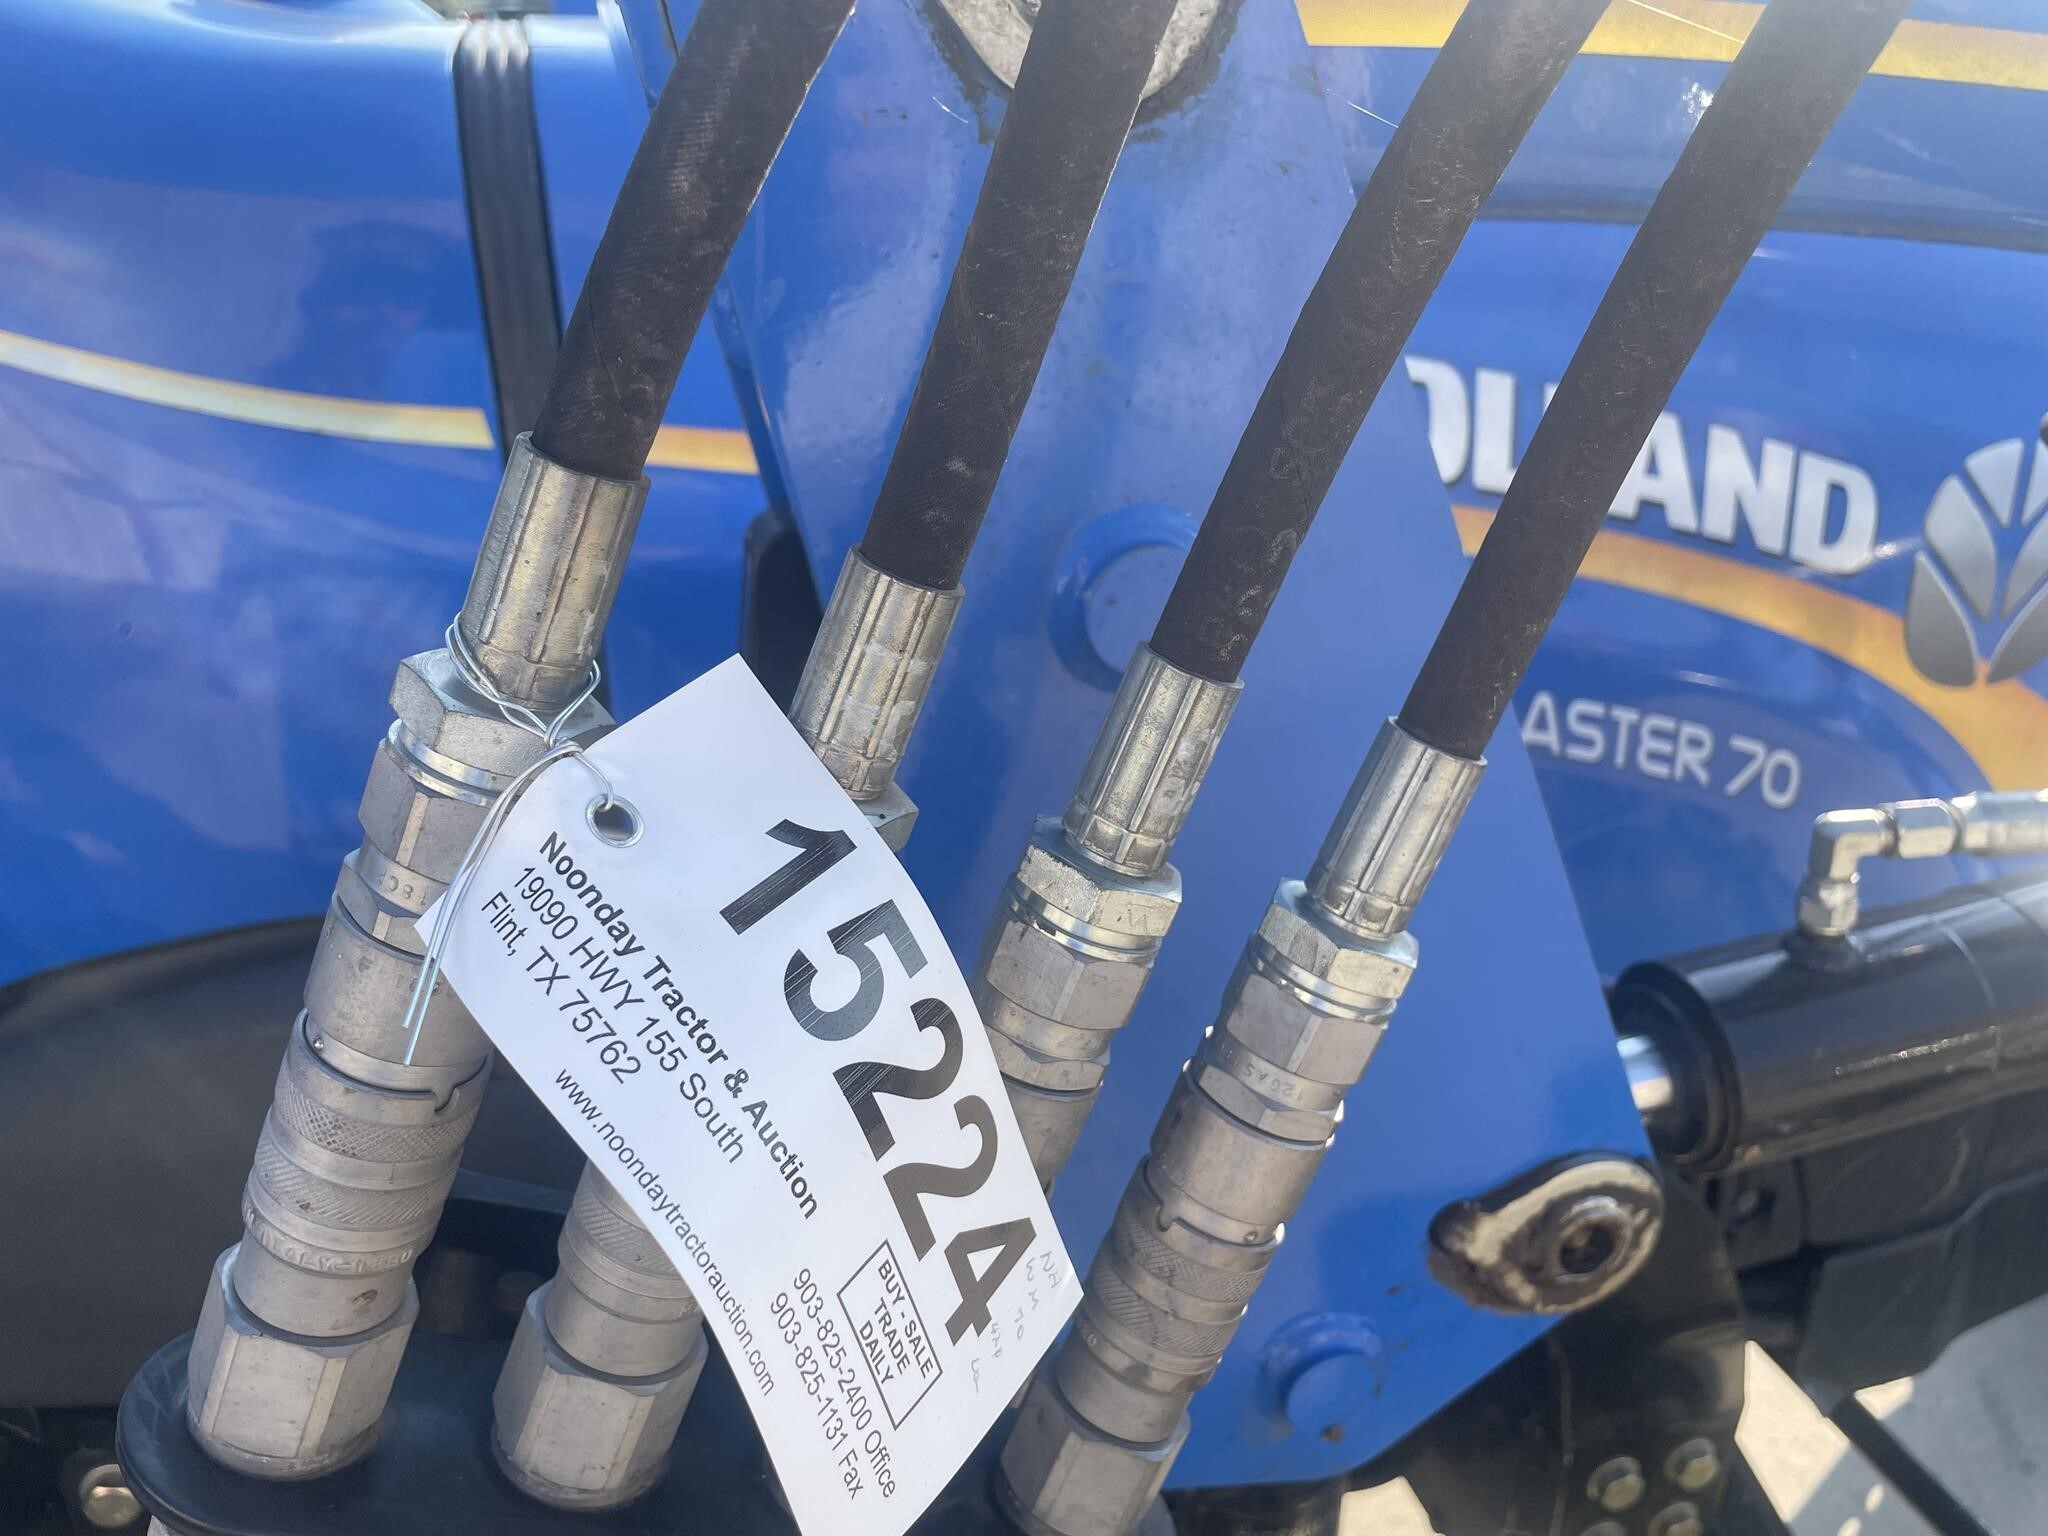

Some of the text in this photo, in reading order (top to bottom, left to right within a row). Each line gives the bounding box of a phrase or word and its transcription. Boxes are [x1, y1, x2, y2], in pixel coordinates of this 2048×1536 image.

[1520, 690, 1800, 811] ASTER 70
[481, 891, 641, 1084] Flint, TX 75762
[514, 867, 744, 1164] 19090 HWY 155 South
[539, 831, 818, 1220] Noonday Tractor & Auction
[719, 817, 1037, 1347] 15224
[555, 1068, 775, 1396] www.noondaytractorauction.com
[874, 1297, 911, 1374] TRADE
[878, 1258, 905, 1306] BUY
[904, 1319, 934, 1379] SALE
[770, 1292, 864, 1500] 903-825-1131 Fax
[793, 1268, 896, 1498] 903-825-2400 Office
[859, 1320, 894, 1385] DAILY
